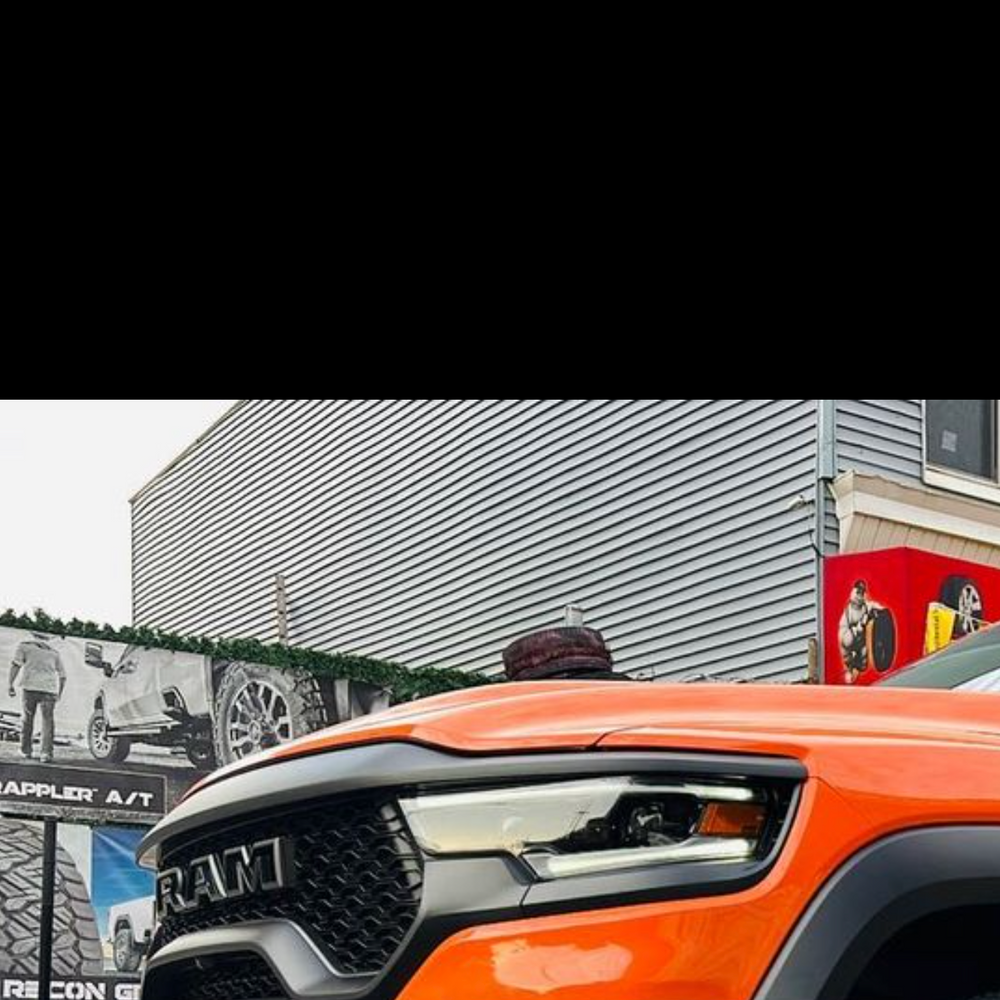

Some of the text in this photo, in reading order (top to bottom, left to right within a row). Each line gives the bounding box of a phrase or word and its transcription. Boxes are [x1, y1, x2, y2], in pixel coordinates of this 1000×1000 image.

[105, 788, 154, 807] A/T
[157, 837, 284, 920] RAM
[2, 978, 107, 1000] RECON
